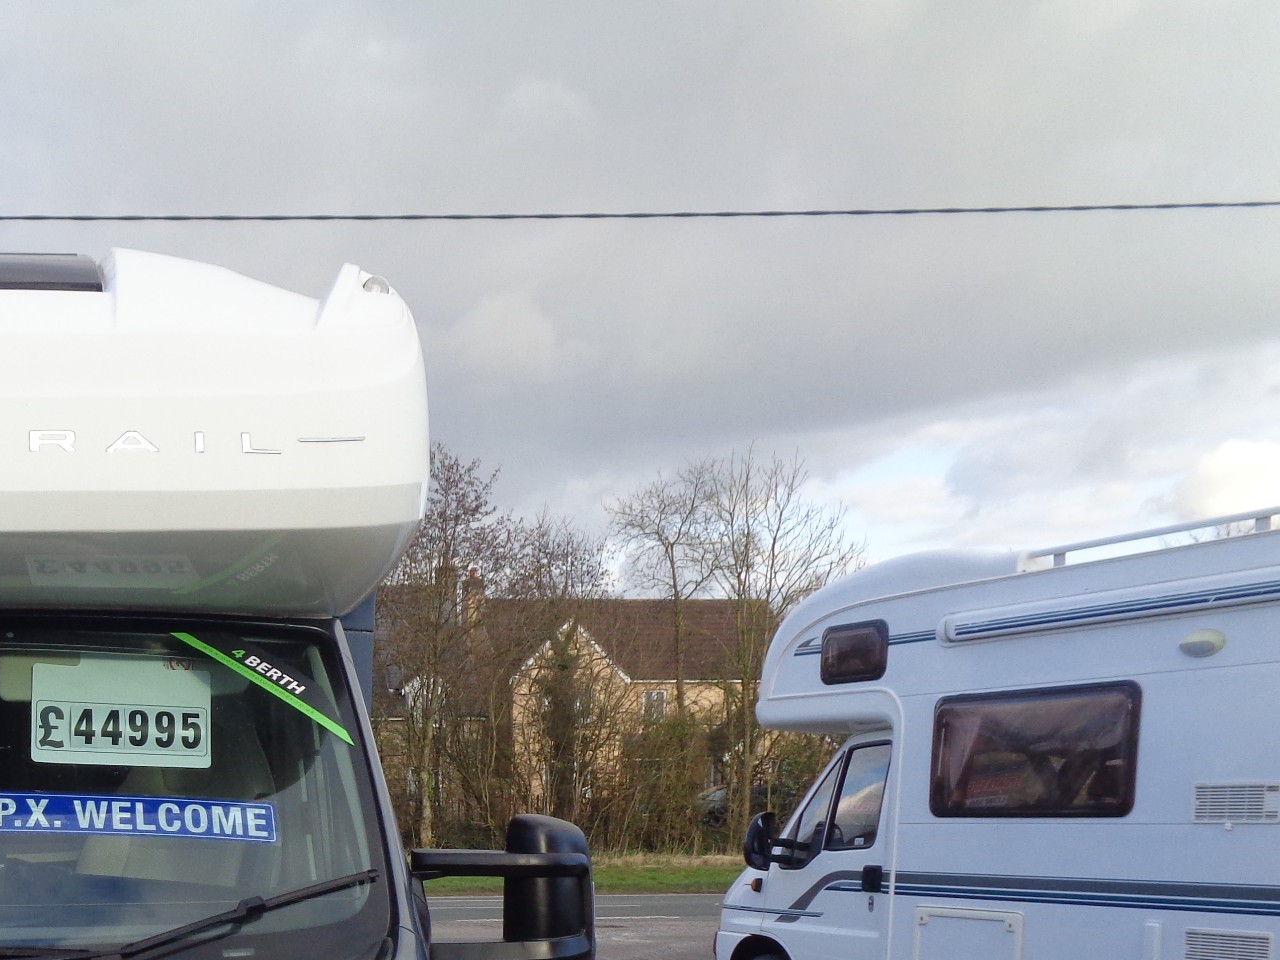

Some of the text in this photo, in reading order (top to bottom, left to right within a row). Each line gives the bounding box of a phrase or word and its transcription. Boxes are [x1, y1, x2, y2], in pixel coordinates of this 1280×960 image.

[231, 649, 307, 695] 4 BERTH
[38, 705, 202, 750] £44995
[72, 799, 270, 837] WELCOME
